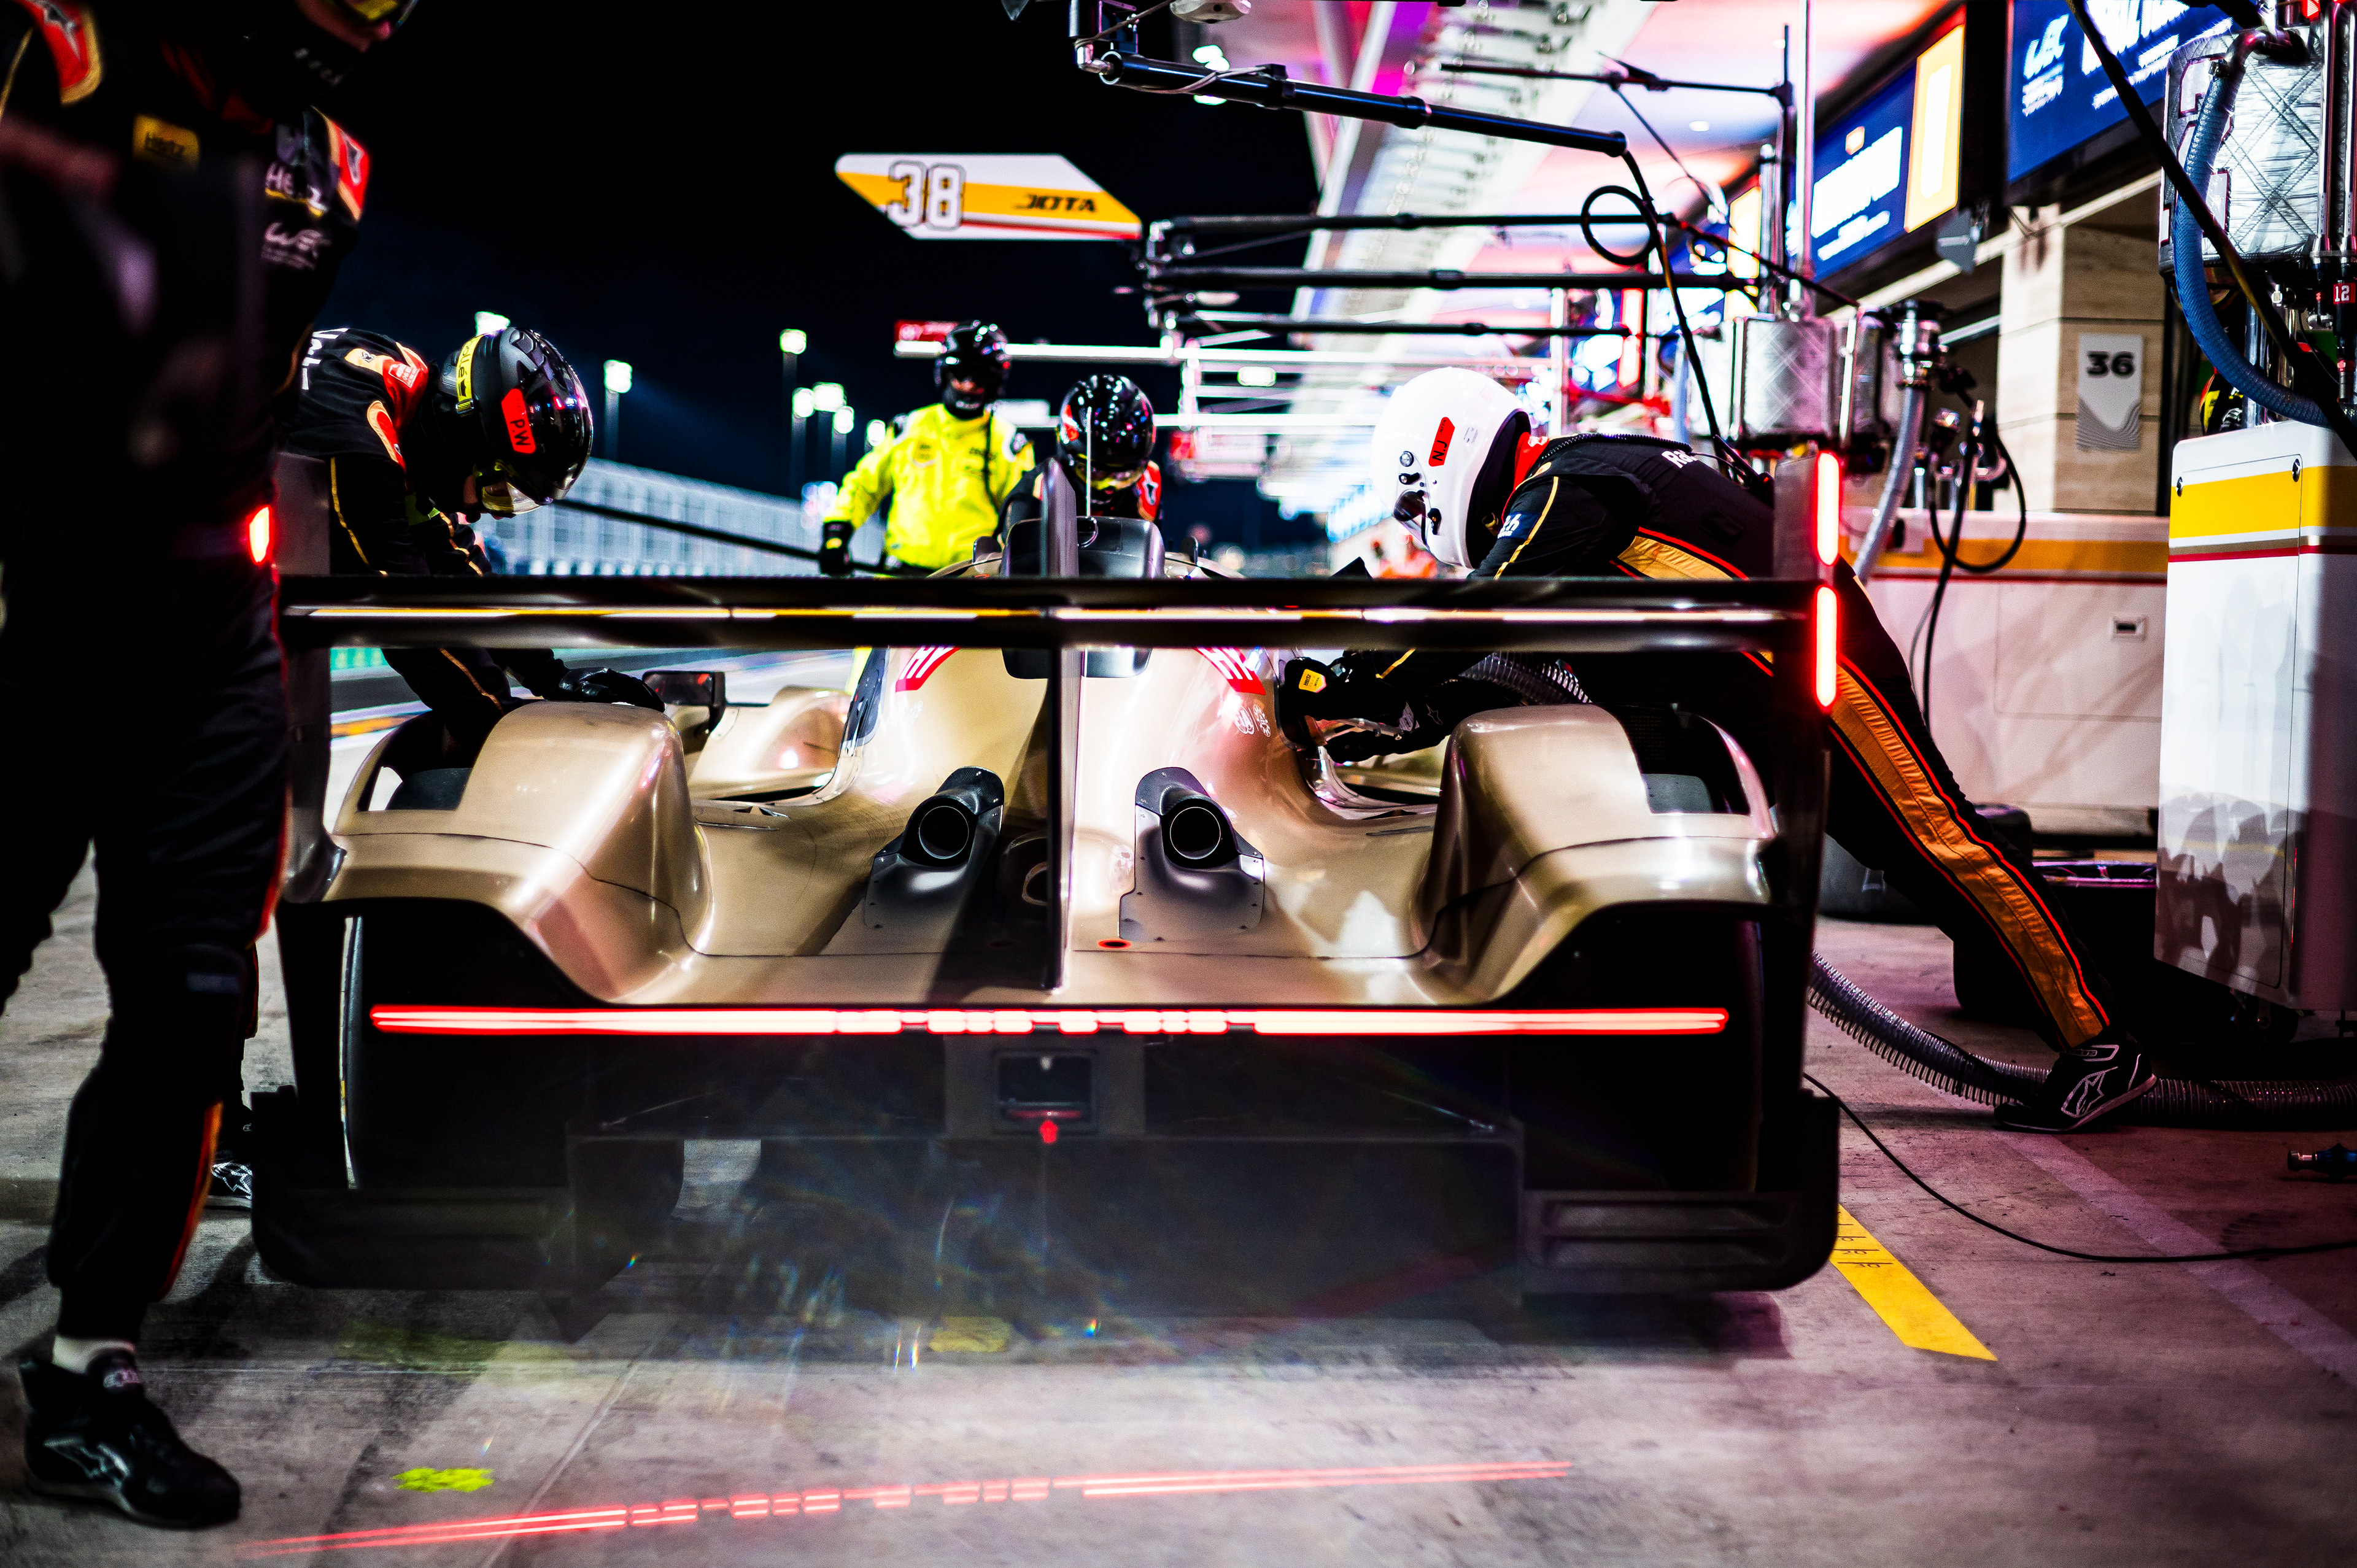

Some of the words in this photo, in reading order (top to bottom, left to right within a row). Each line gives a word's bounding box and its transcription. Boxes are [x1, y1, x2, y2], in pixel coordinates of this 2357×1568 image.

[887, 160, 966, 231] 38
[1013, 193, 1097, 213] JOTA
[2334, 285, 2350, 302] 12
[2086, 350, 2135, 379] 36
[1431, 440, 1447, 462] N.J
[1303, 674, 1312, 687] Hertz
